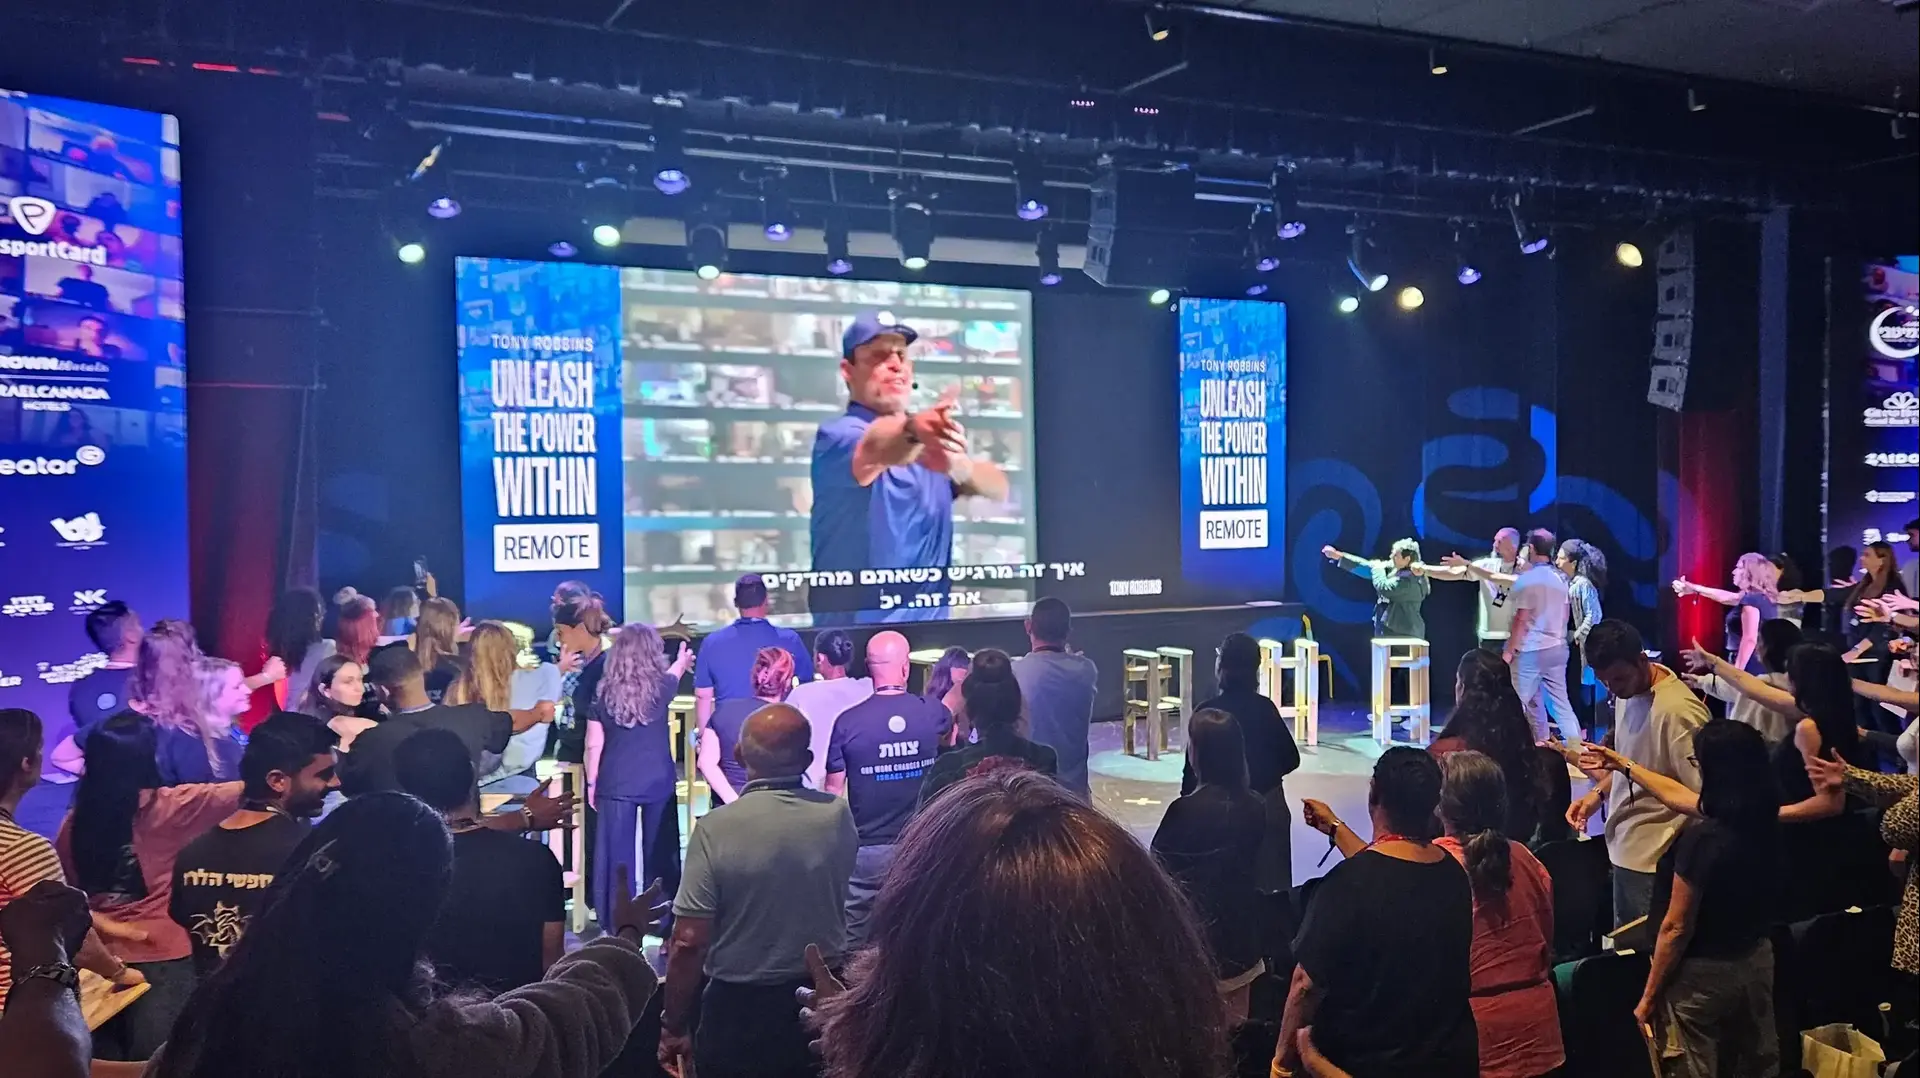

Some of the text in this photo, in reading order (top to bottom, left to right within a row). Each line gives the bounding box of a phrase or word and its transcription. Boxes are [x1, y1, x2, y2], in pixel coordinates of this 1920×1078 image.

[491, 333, 593, 352] TONY ROBBINS
[1201, 359, 1266, 373] TONY ROBBINS
[491, 359, 594, 408] UNLEASH
[1201, 379, 1266, 418] UNLEASH
[491, 412, 597, 452] THE POWER
[1200, 422, 1267, 454] THE POWER
[493, 456, 597, 516] WITHIN
[1200, 457, 1267, 505] WITHIN
[1206, 519, 1261, 540] REMOTE
[504, 535, 589, 560] REMOTE
[761, 562, 1085, 591] איך זה מרגיש כשאתם מהדקים
[907, 592, 944, 608] זה.
[948, 590, 981, 607] את
[1109, 581, 1130, 596] TONY
[879, 740, 920, 758] צוות
[876, 772, 904, 781] ISRAEL
